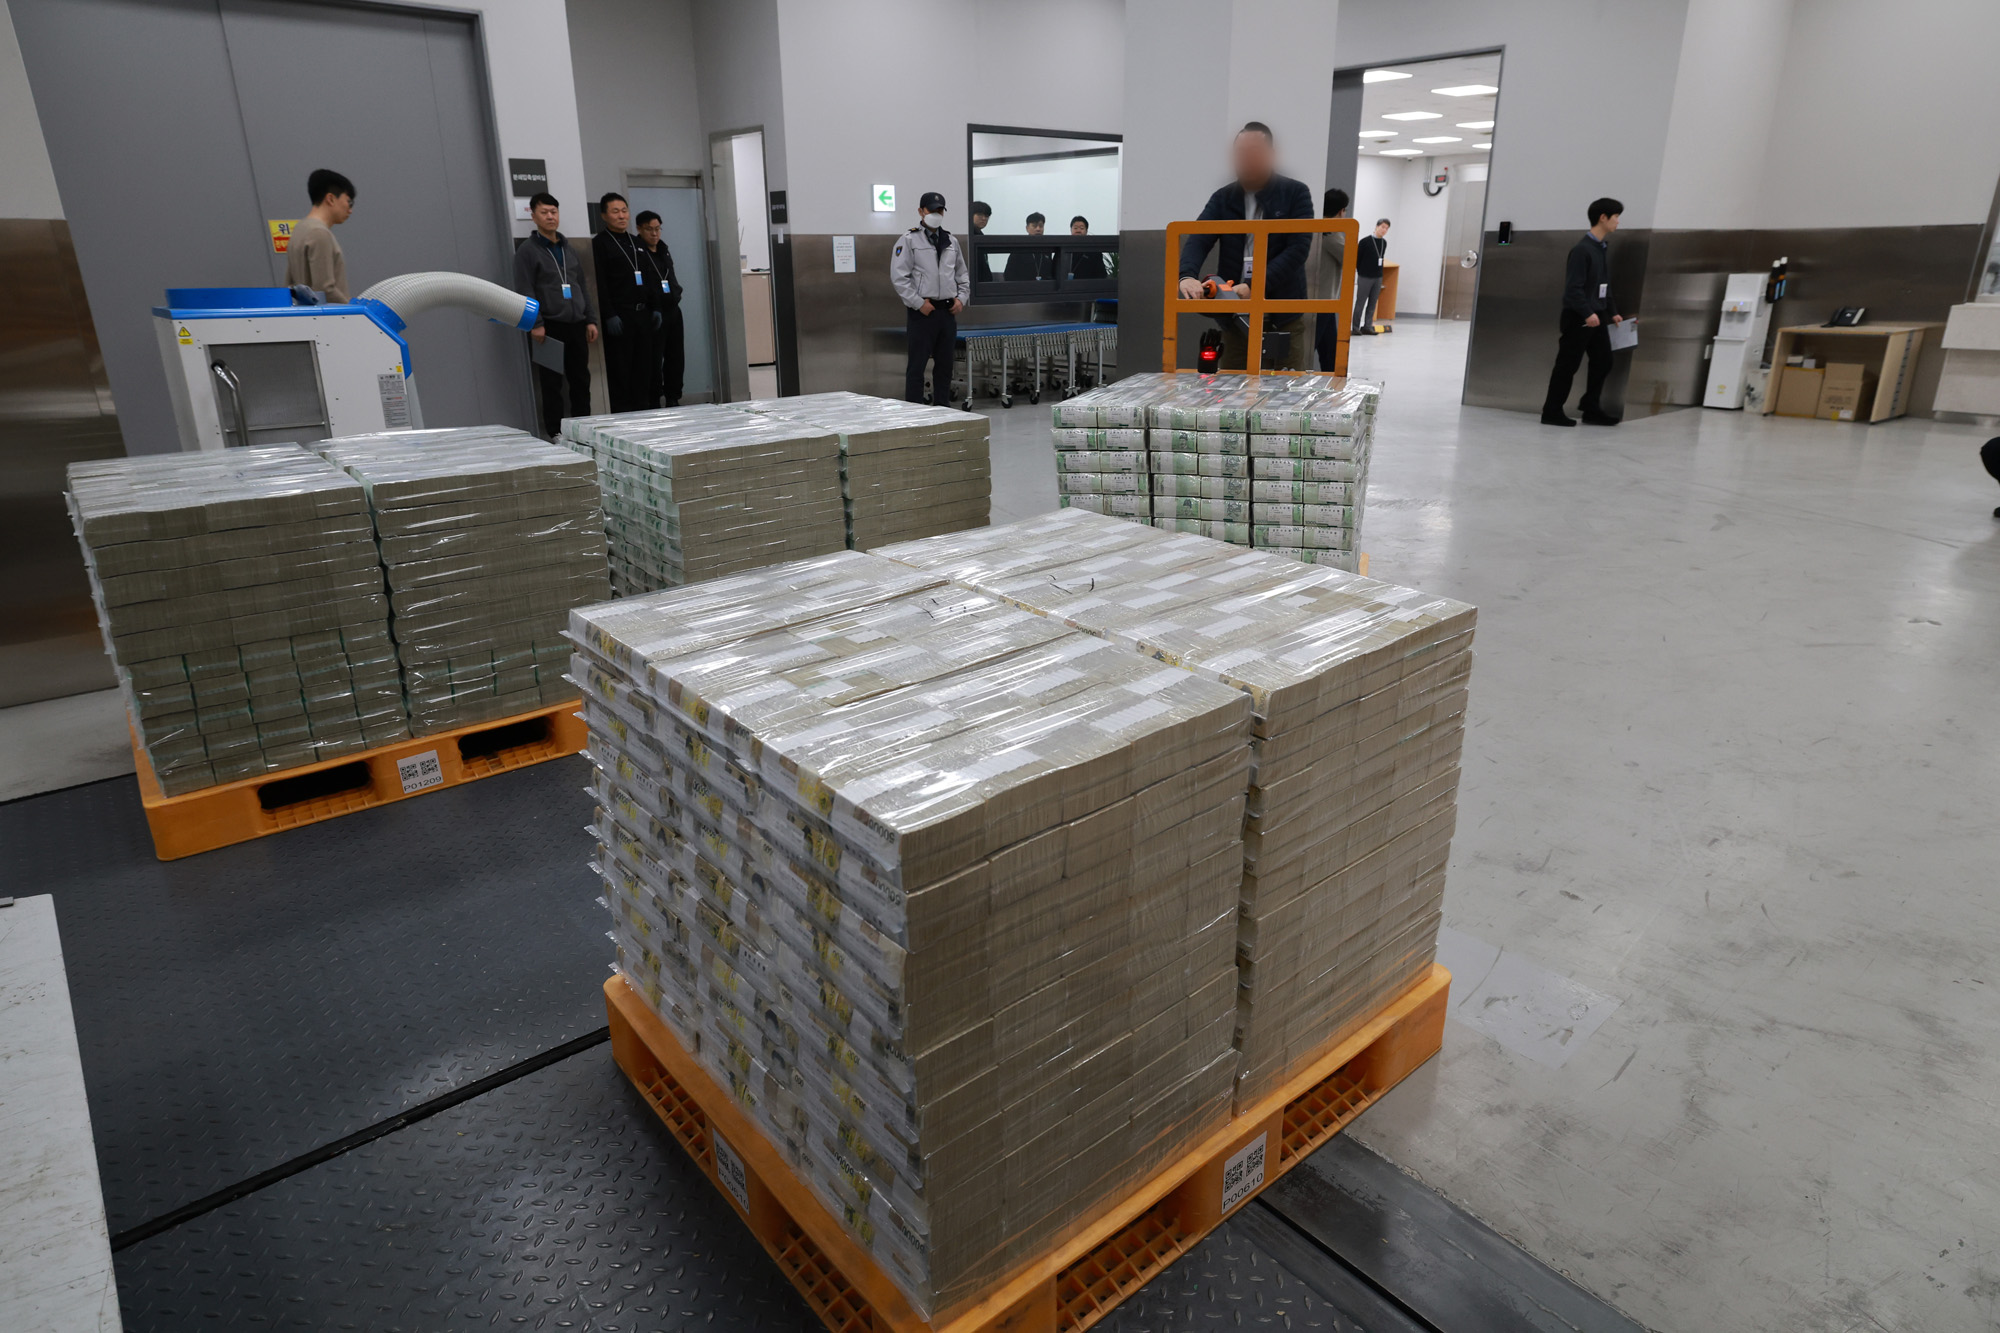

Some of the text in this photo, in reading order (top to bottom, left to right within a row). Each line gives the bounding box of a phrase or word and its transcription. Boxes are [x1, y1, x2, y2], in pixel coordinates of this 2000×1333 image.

[403, 776, 442, 792] P01209
[868, 818, 896, 844] 50000
[1222, 1172, 1263, 1210] P00610
